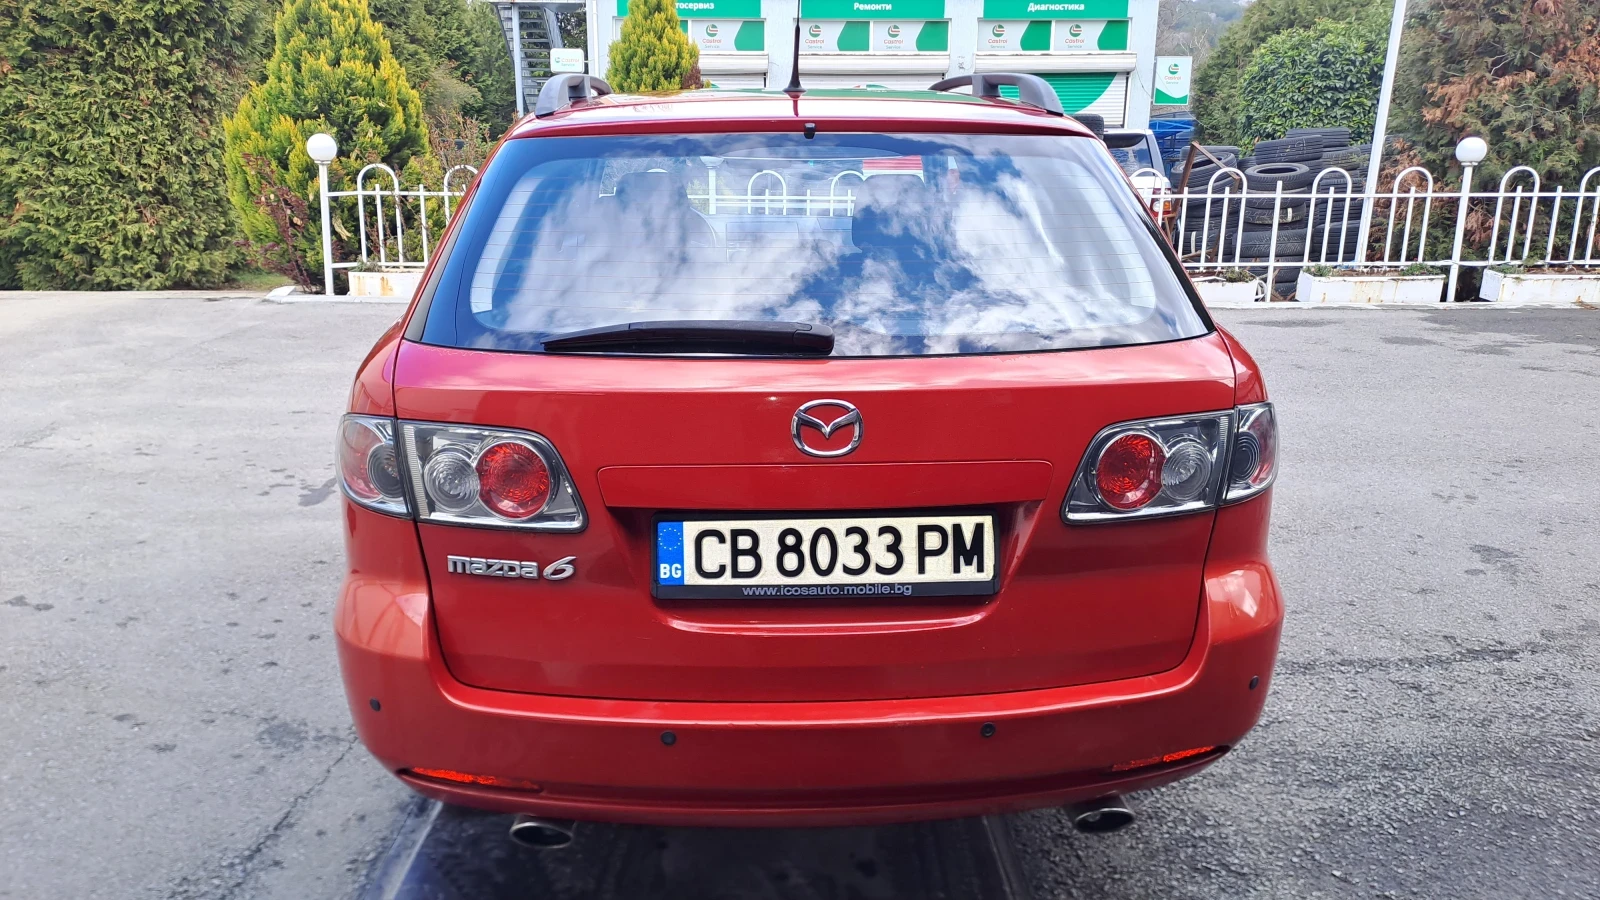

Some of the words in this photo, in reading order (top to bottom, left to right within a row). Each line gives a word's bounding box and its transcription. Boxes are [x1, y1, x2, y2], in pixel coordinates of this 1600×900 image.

[675, 2, 715, 11] тосервиз
[853, 2, 892, 11] Ремонти
[1027, 2, 1085, 12] Диагностика
[694, 528, 763, 580] CB
[776, 525, 904, 578] 8033
[917, 522, 985, 575] PM
[542, 555, 577, 581] 6
[659, 563, 682, 579] BG
[742, 582, 913, 597] www.icosauto.mobile.bg
